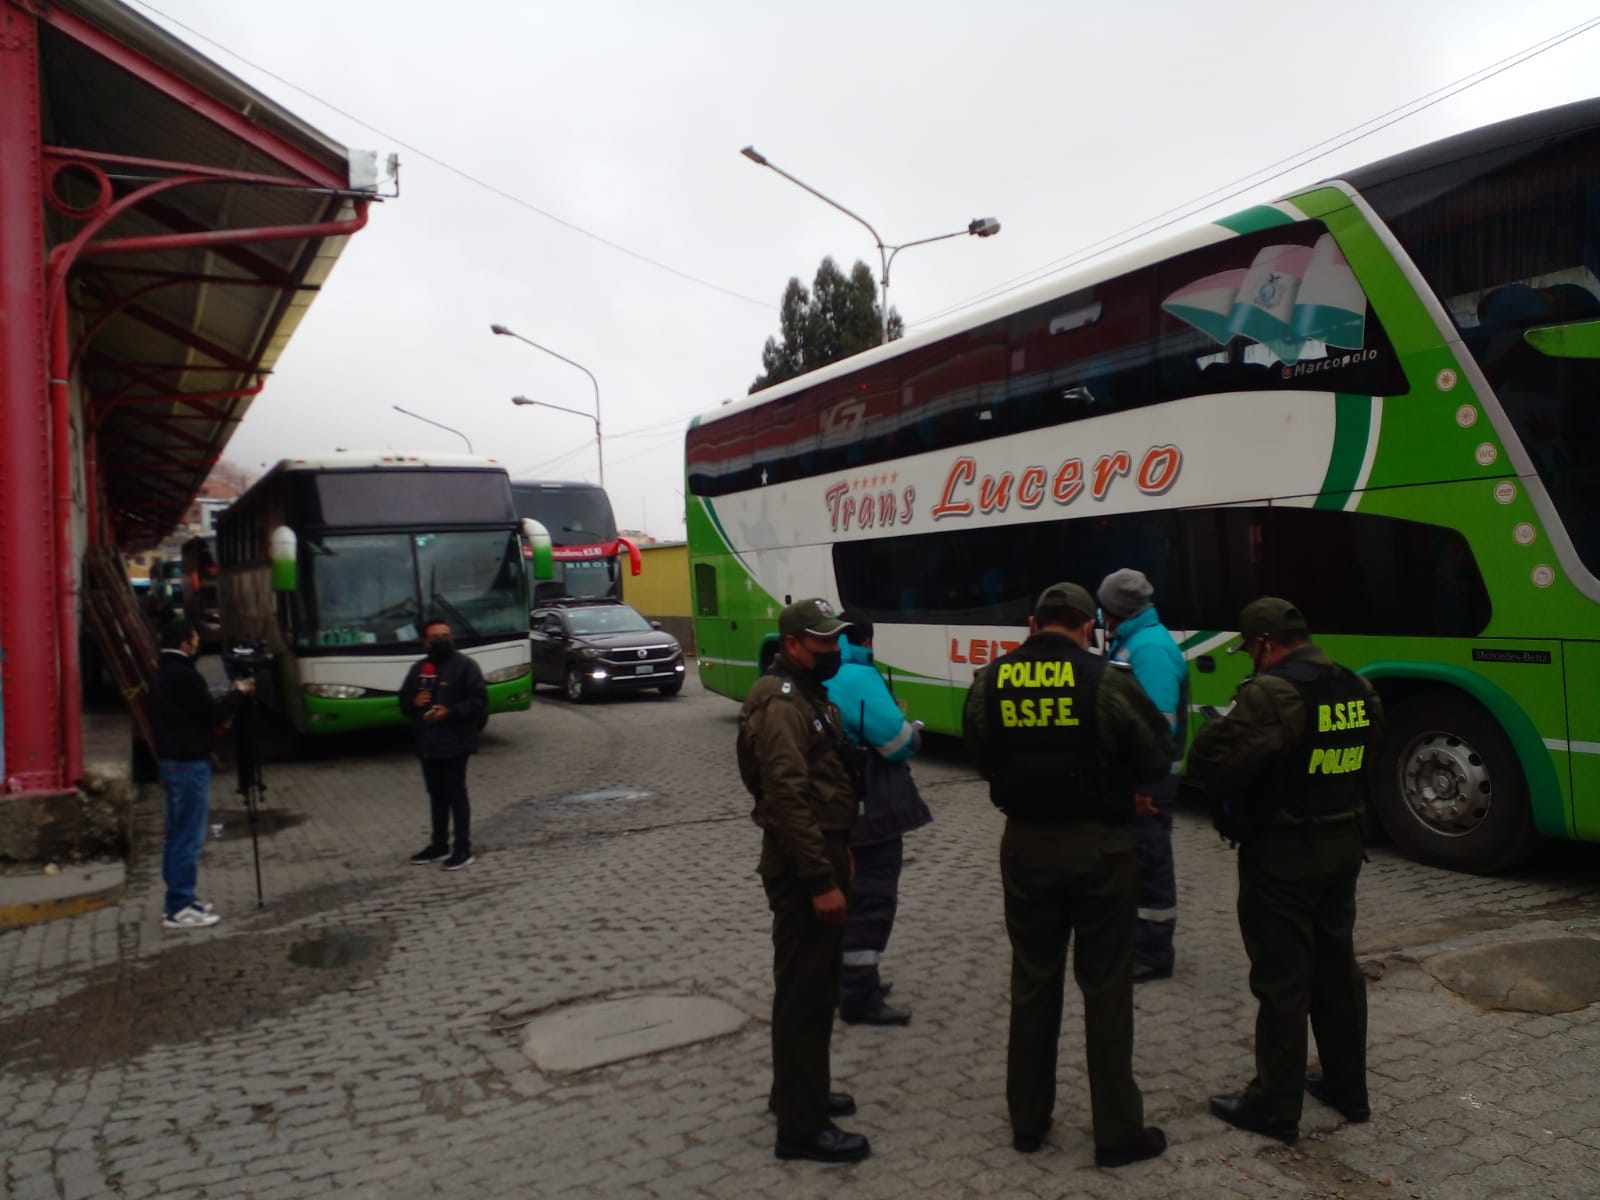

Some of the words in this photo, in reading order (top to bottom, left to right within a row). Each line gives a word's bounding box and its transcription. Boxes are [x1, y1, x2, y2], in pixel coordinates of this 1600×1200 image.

[1294, 349, 1378, 377] Marcopolo
[1479, 449, 1495, 458] WC
[825, 481, 915, 531] Trans
[931, 443, 1183, 522] Lucero
[950, 637, 1023, 665] LEIT
[997, 661, 1076, 688] POLICIA
[1000, 697, 1080, 728] B.S.F.E.
